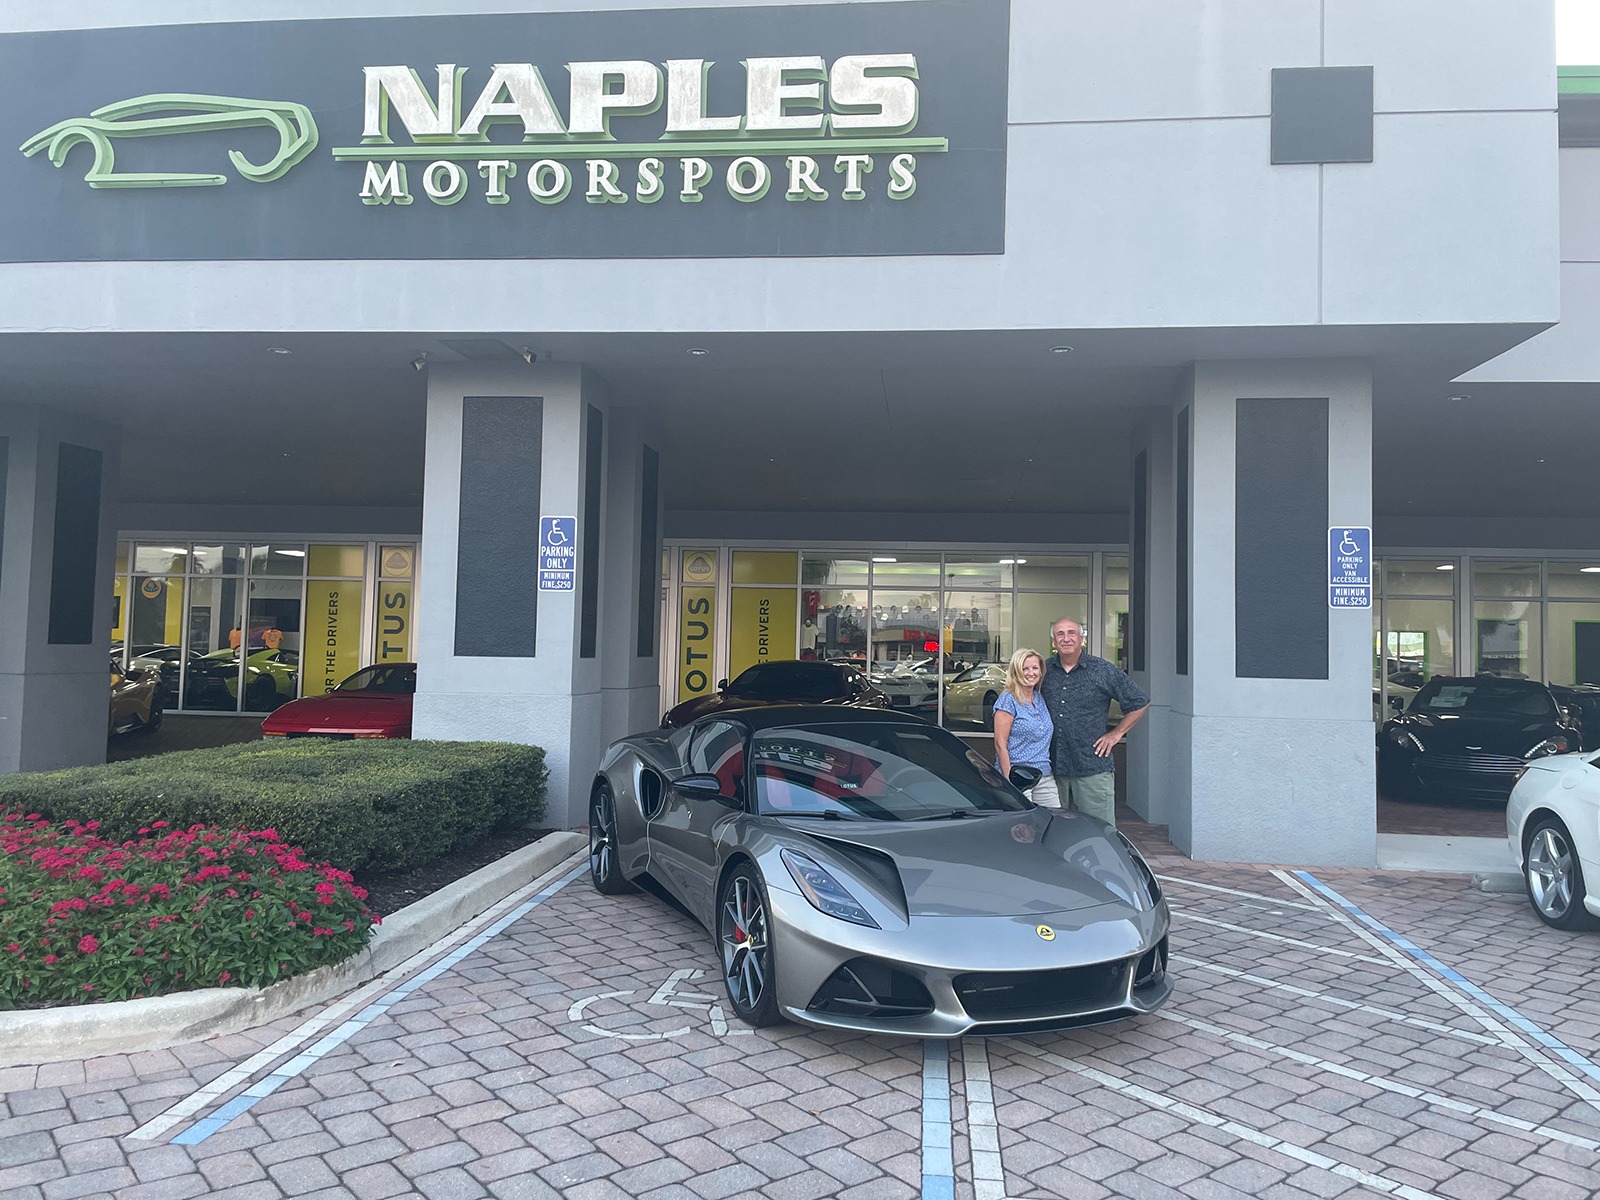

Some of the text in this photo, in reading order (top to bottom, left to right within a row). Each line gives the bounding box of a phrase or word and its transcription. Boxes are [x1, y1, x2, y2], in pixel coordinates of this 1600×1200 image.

[361, 53, 919, 142] NAPLES
[359, 153, 917, 205] MOTORSPORTS
[541, 546, 574, 557] PARKING
[543, 572, 570, 580] MINIMUM
[546, 558, 567, 569] ONLY
[1335, 588, 1365, 597] MINIMUM
[324, 591, 339, 695] OR THE DRIVERS
[382, 592, 406, 659] TUS
[685, 597, 710, 692] OTUS
[758, 599, 769, 655] DRIVERS
